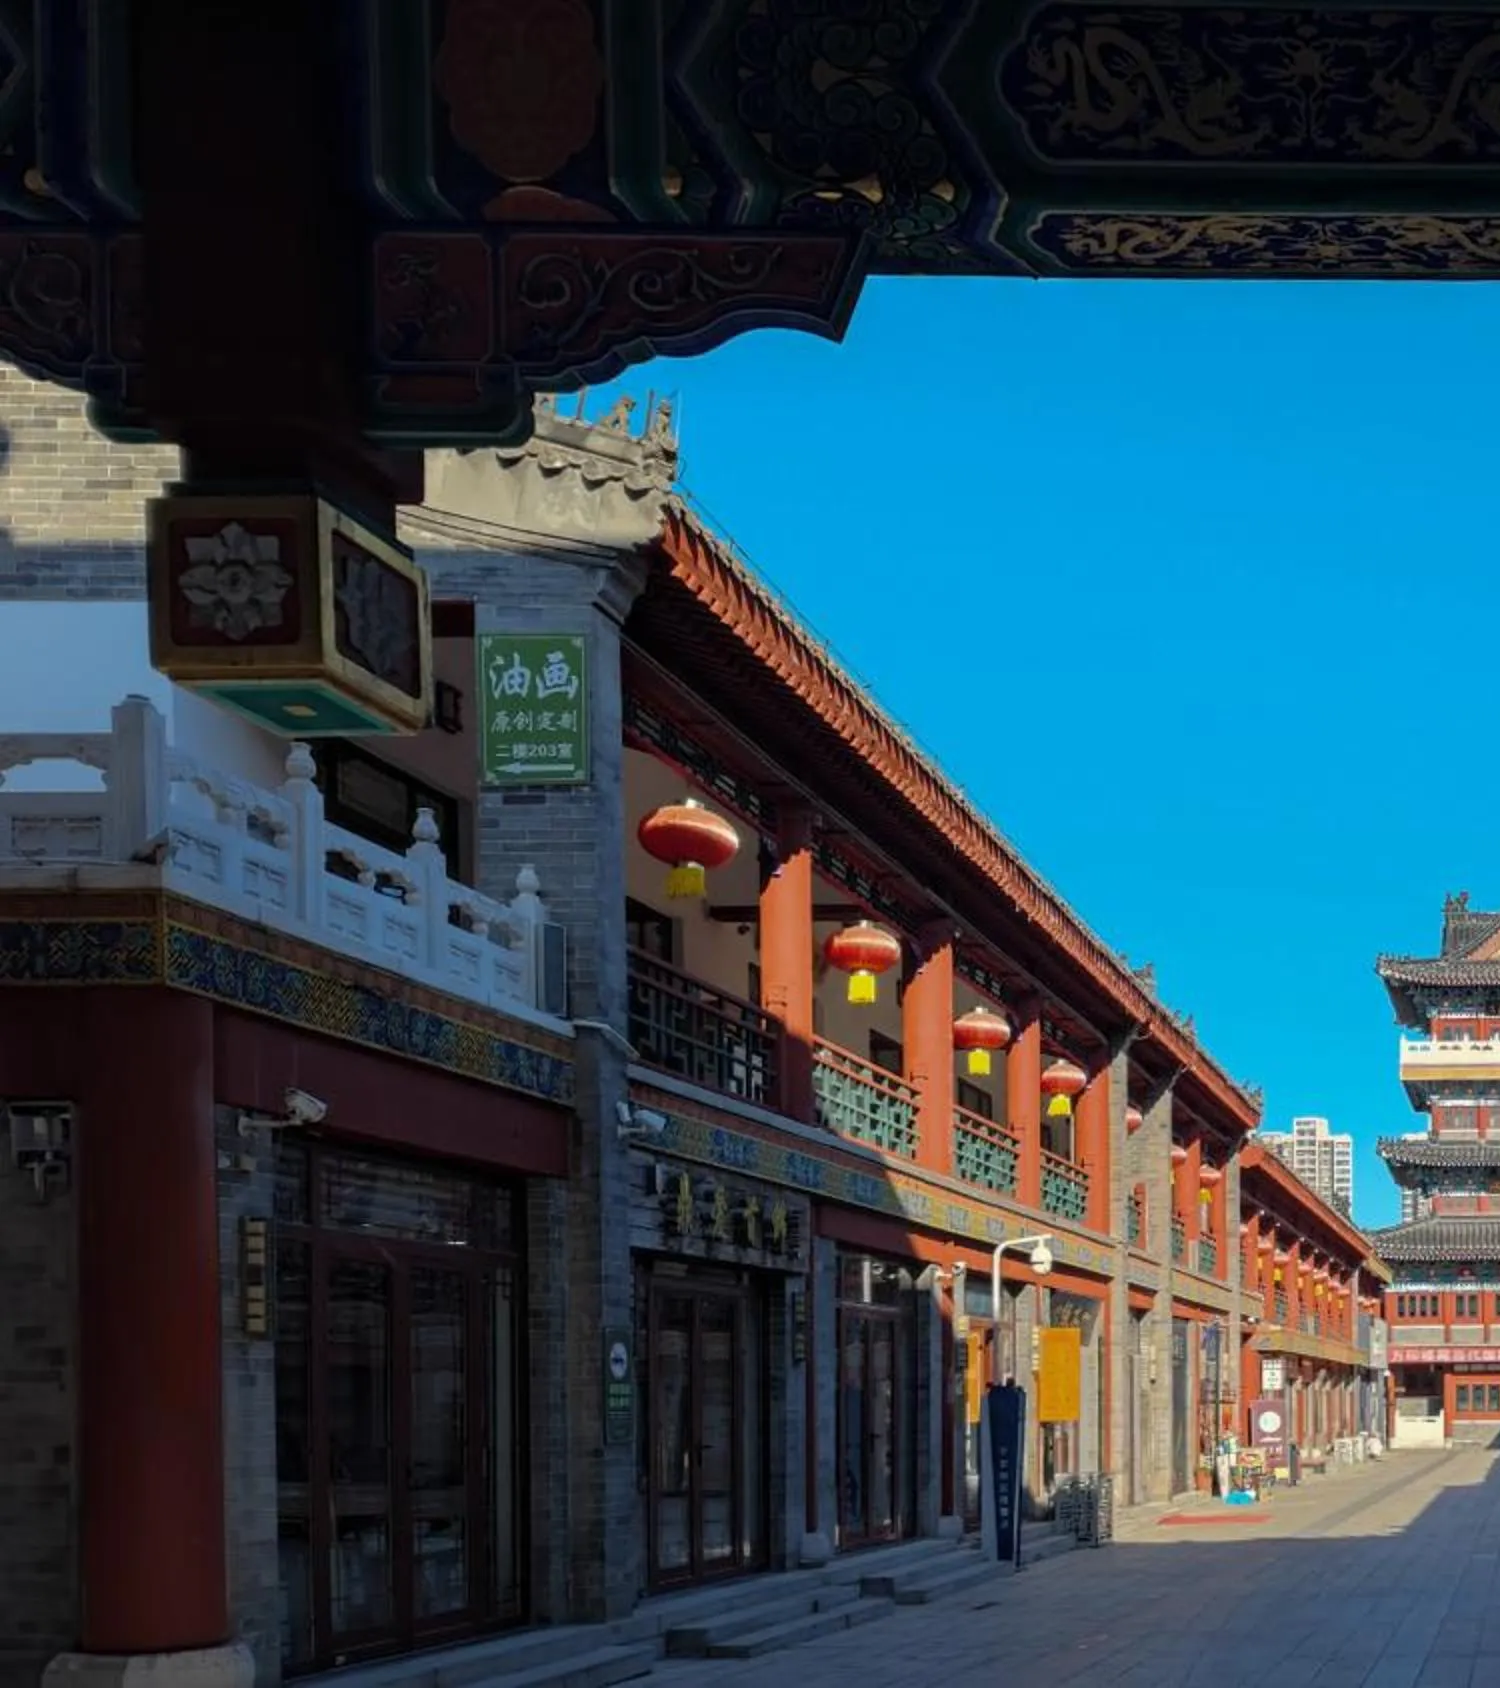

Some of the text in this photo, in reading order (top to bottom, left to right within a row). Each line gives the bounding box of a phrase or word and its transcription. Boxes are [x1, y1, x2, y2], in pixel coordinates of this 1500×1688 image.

[489, 651, 579, 699] 油画
[490, 710, 577, 733] 原创定制
